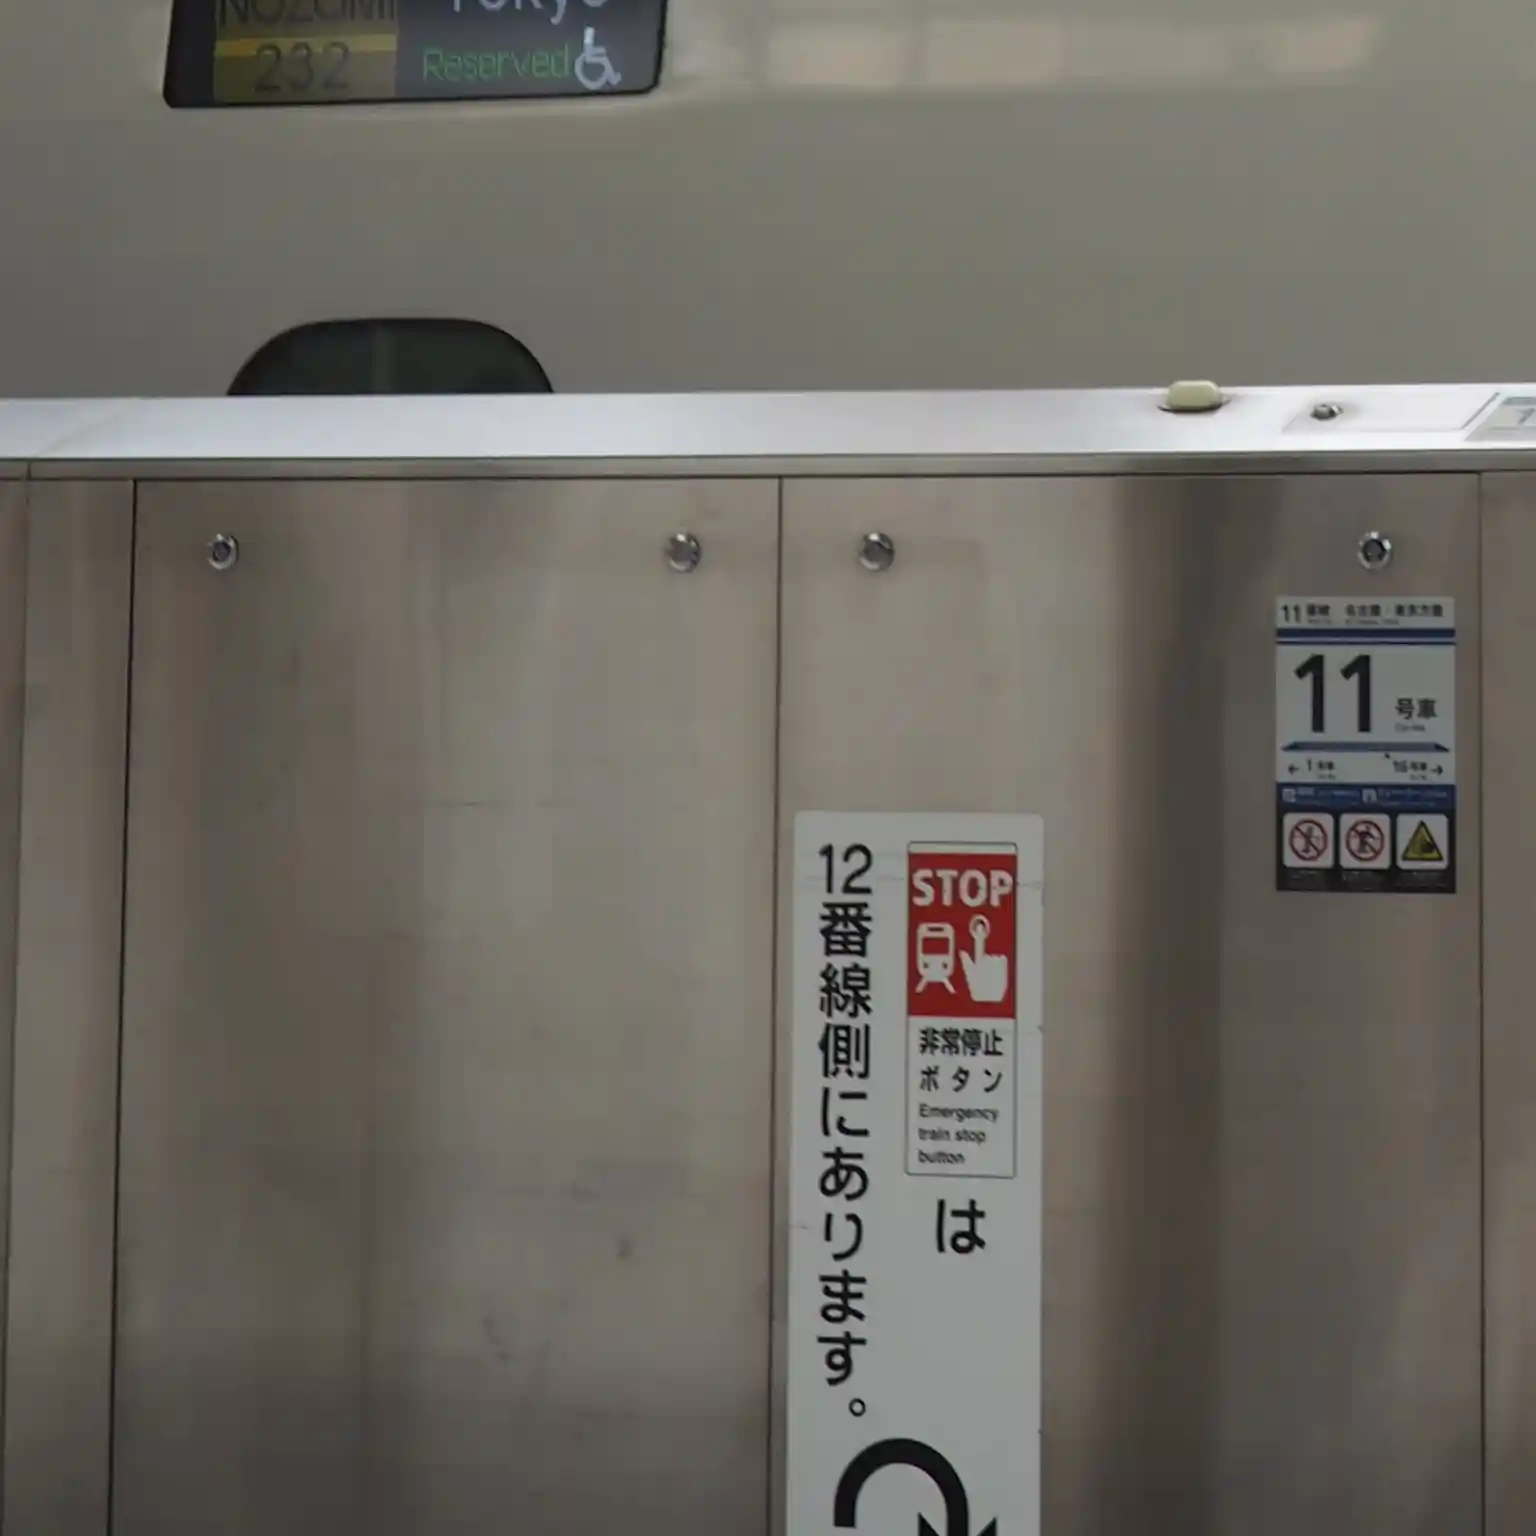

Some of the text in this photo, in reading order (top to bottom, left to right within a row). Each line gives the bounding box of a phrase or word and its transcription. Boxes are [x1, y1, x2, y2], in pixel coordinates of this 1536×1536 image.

[254, 41, 353, 94] 232
[422, 43, 570, 82] Reserved
[1293, 653, 1372, 733] 11
[912, 868, 1013, 907] STOP
[919, 1026, 1004, 1057] 非常停止
[919, 1065, 1003, 1093] ボタン
[919, 1102, 998, 1123] Emergency
[918, 1127, 986, 1146] train stop
[918, 1150, 966, 1164] button
[936, 1197, 986, 1255] は
